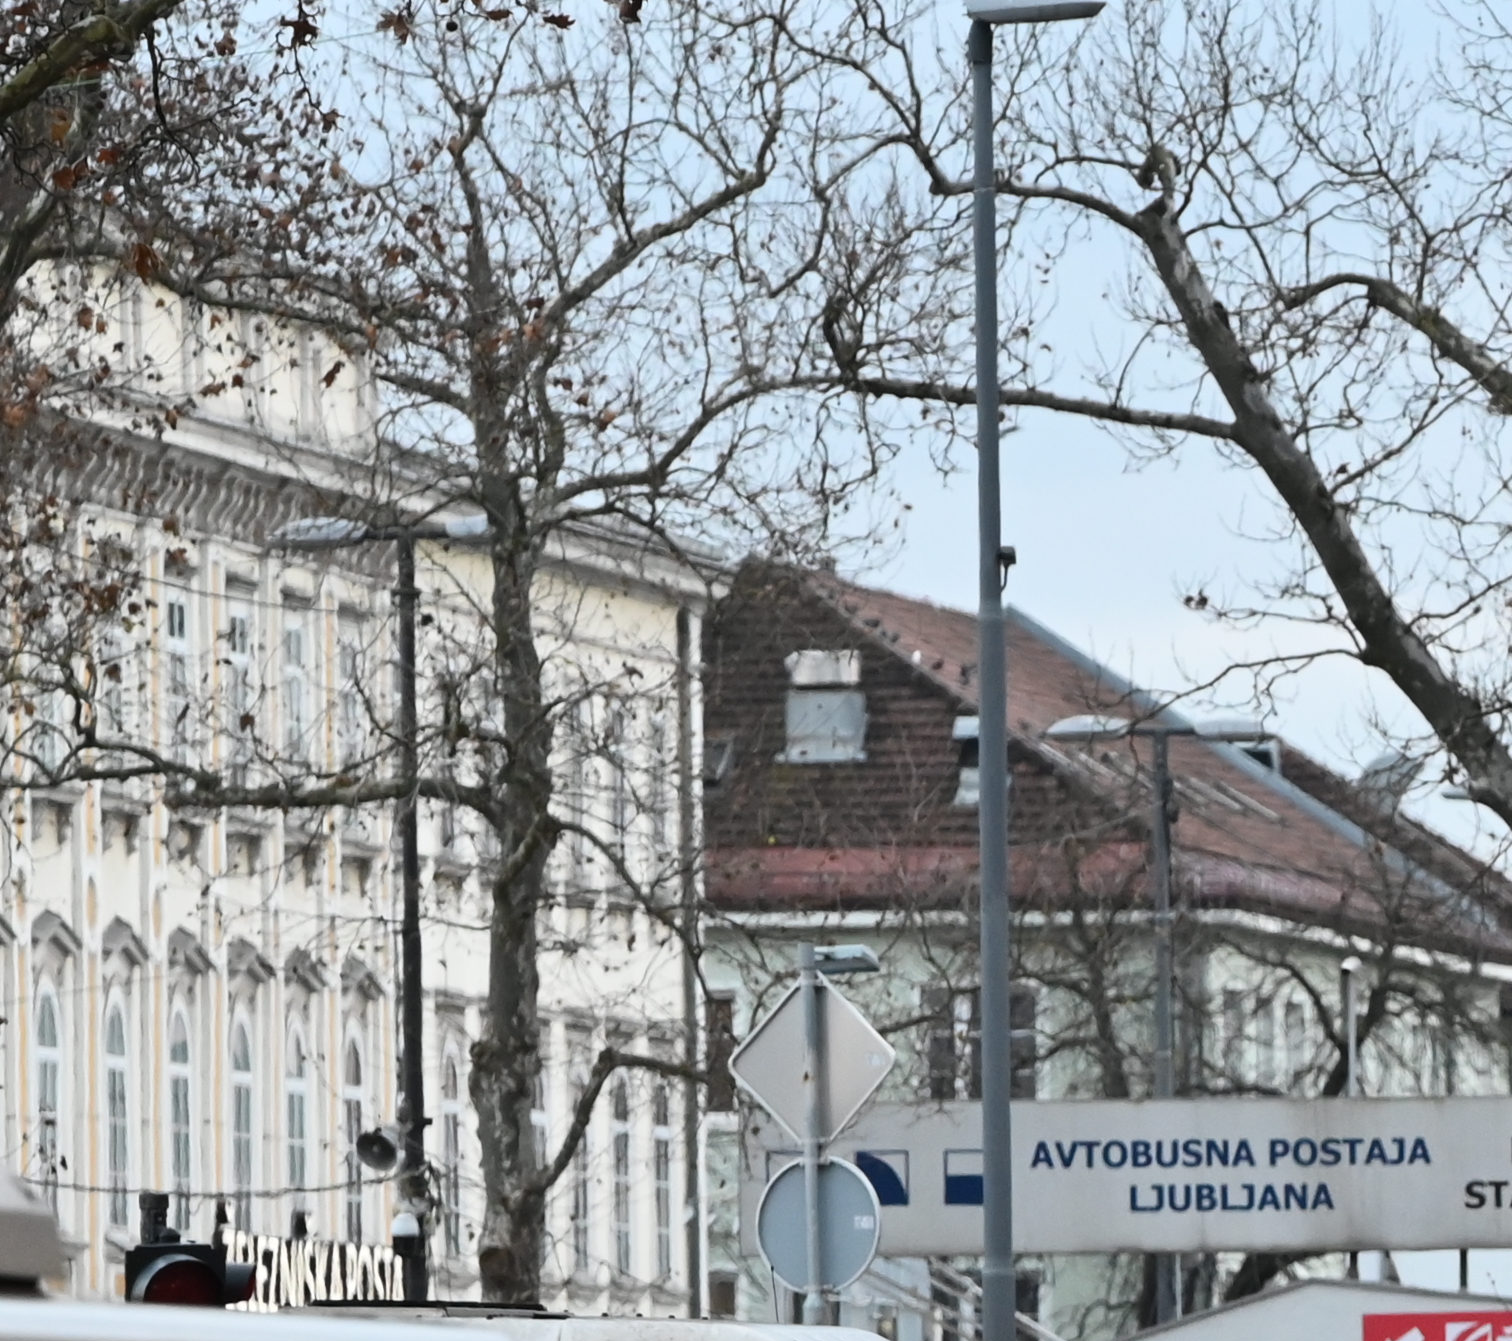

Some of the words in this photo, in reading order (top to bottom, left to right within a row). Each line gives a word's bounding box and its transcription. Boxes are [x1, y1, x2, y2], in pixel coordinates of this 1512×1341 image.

[1031, 1139, 1255, 1169] AVTOBUSNA
[1269, 1137, 1431, 1167] POSTAJA
[1129, 1183, 1335, 1213] LJUBLJANA
